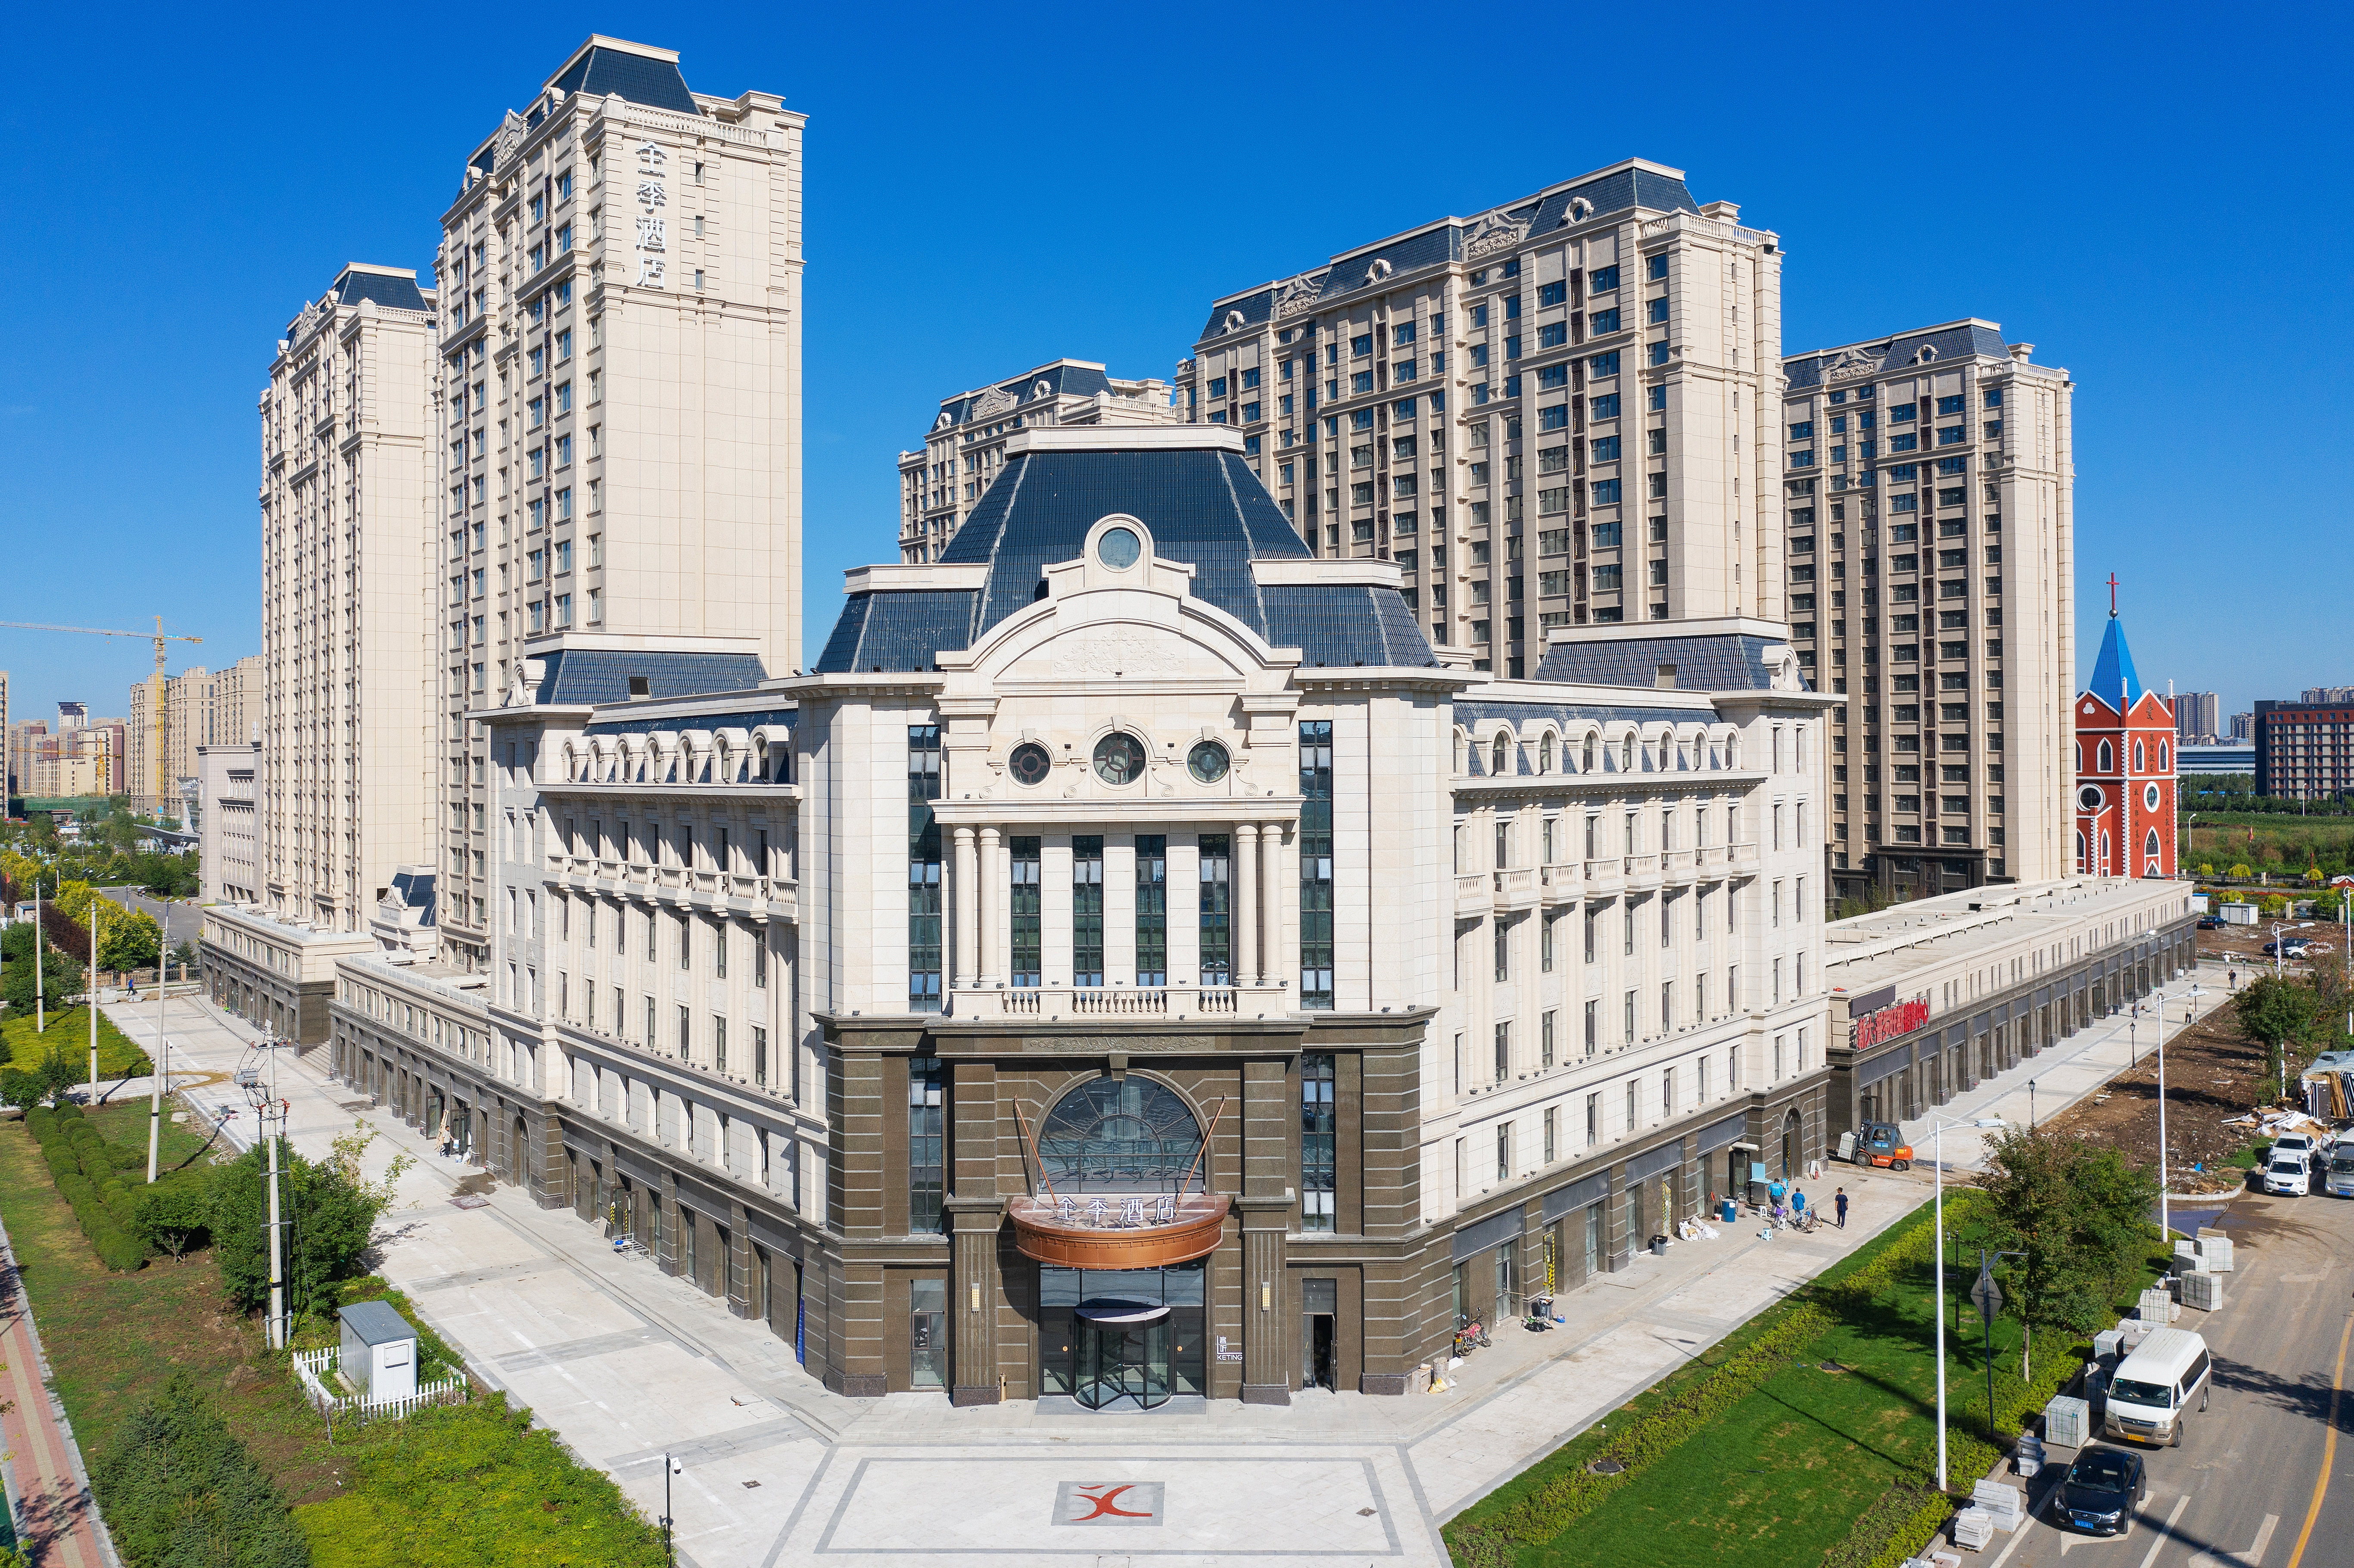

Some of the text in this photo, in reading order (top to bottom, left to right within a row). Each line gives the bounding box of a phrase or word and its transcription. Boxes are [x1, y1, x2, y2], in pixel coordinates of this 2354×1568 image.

[636, 141, 667, 287] 全季酒店
[1057, 1196, 1174, 1223] 全季酒店
